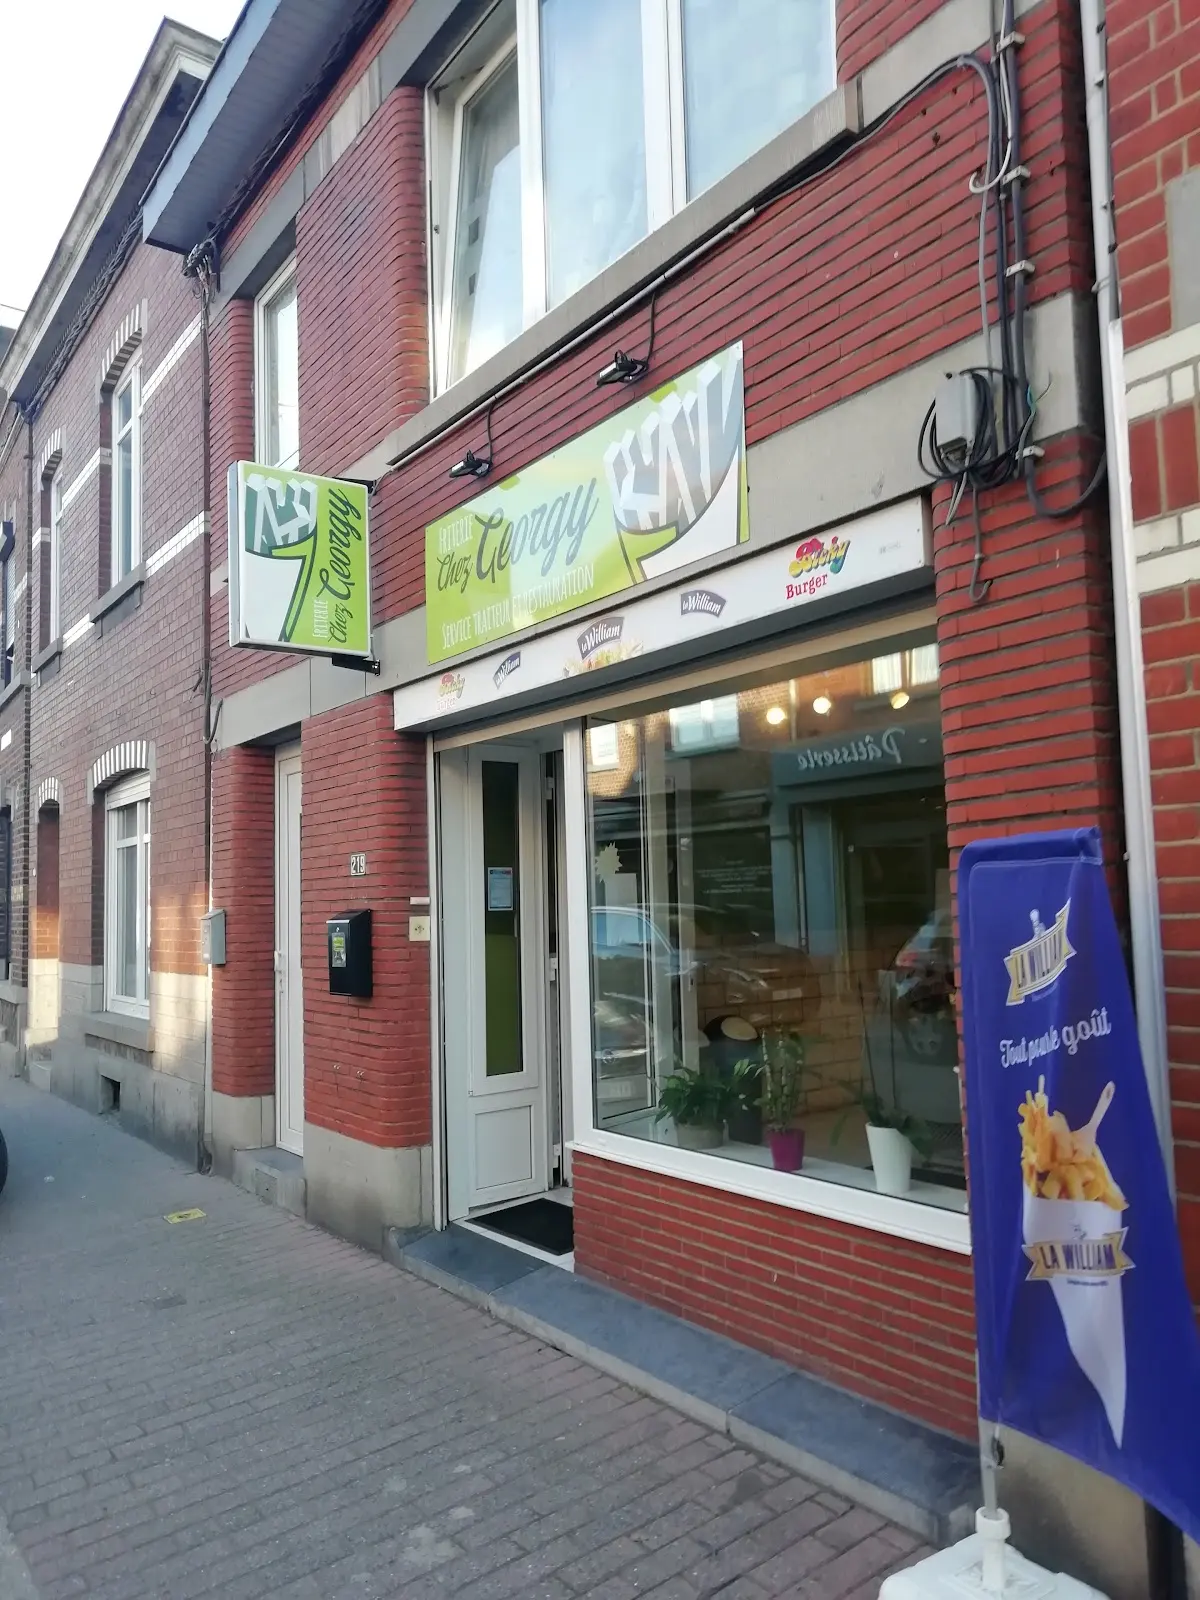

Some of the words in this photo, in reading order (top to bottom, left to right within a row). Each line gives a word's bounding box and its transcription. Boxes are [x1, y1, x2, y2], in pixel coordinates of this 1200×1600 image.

[316, 487, 362, 600] Georgy
[436, 551, 473, 594] Chez
[475, 478, 599, 584] Georgy
[440, 514, 473, 554] FRITERIE
[687, 592, 722, 614] William
[786, 574, 828, 599] Burger
[312, 599, 329, 638] FRITERIE
[328, 602, 353, 643] Chez
[442, 616, 472, 650] SERVICE
[473, 598, 511, 636] TRAITEUR
[523, 563, 594, 617] RESTAURATION
[585, 623, 621, 650] William
[351, 855, 365, 873] 219
[1001, 1037, 1028, 1068] Tout
[1062, 1007, 1112, 1055] goût
[1040, 1245, 1060, 1269] LA
